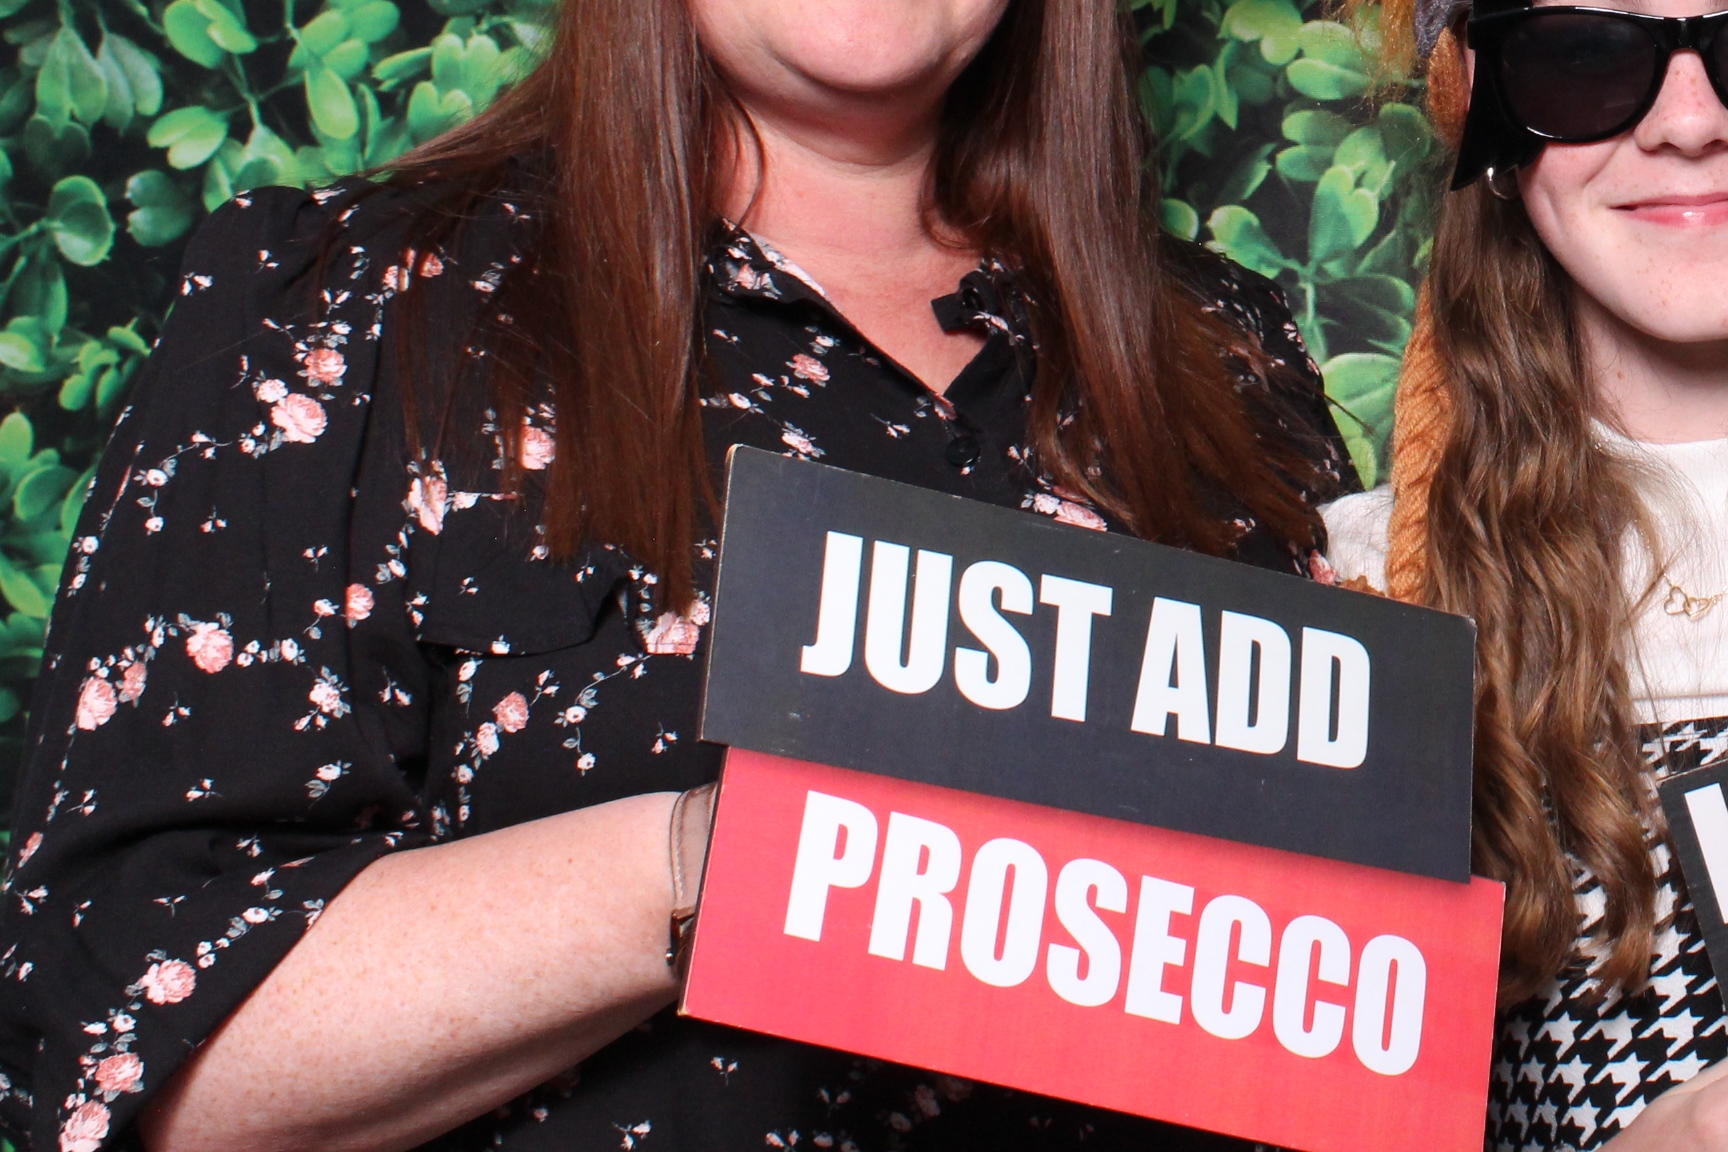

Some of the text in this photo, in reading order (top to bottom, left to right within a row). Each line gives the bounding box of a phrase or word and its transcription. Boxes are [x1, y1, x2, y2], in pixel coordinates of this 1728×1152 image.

[800, 530, 1370, 768] JUST ADD
[783, 789, 1427, 1076] PROSECCO
